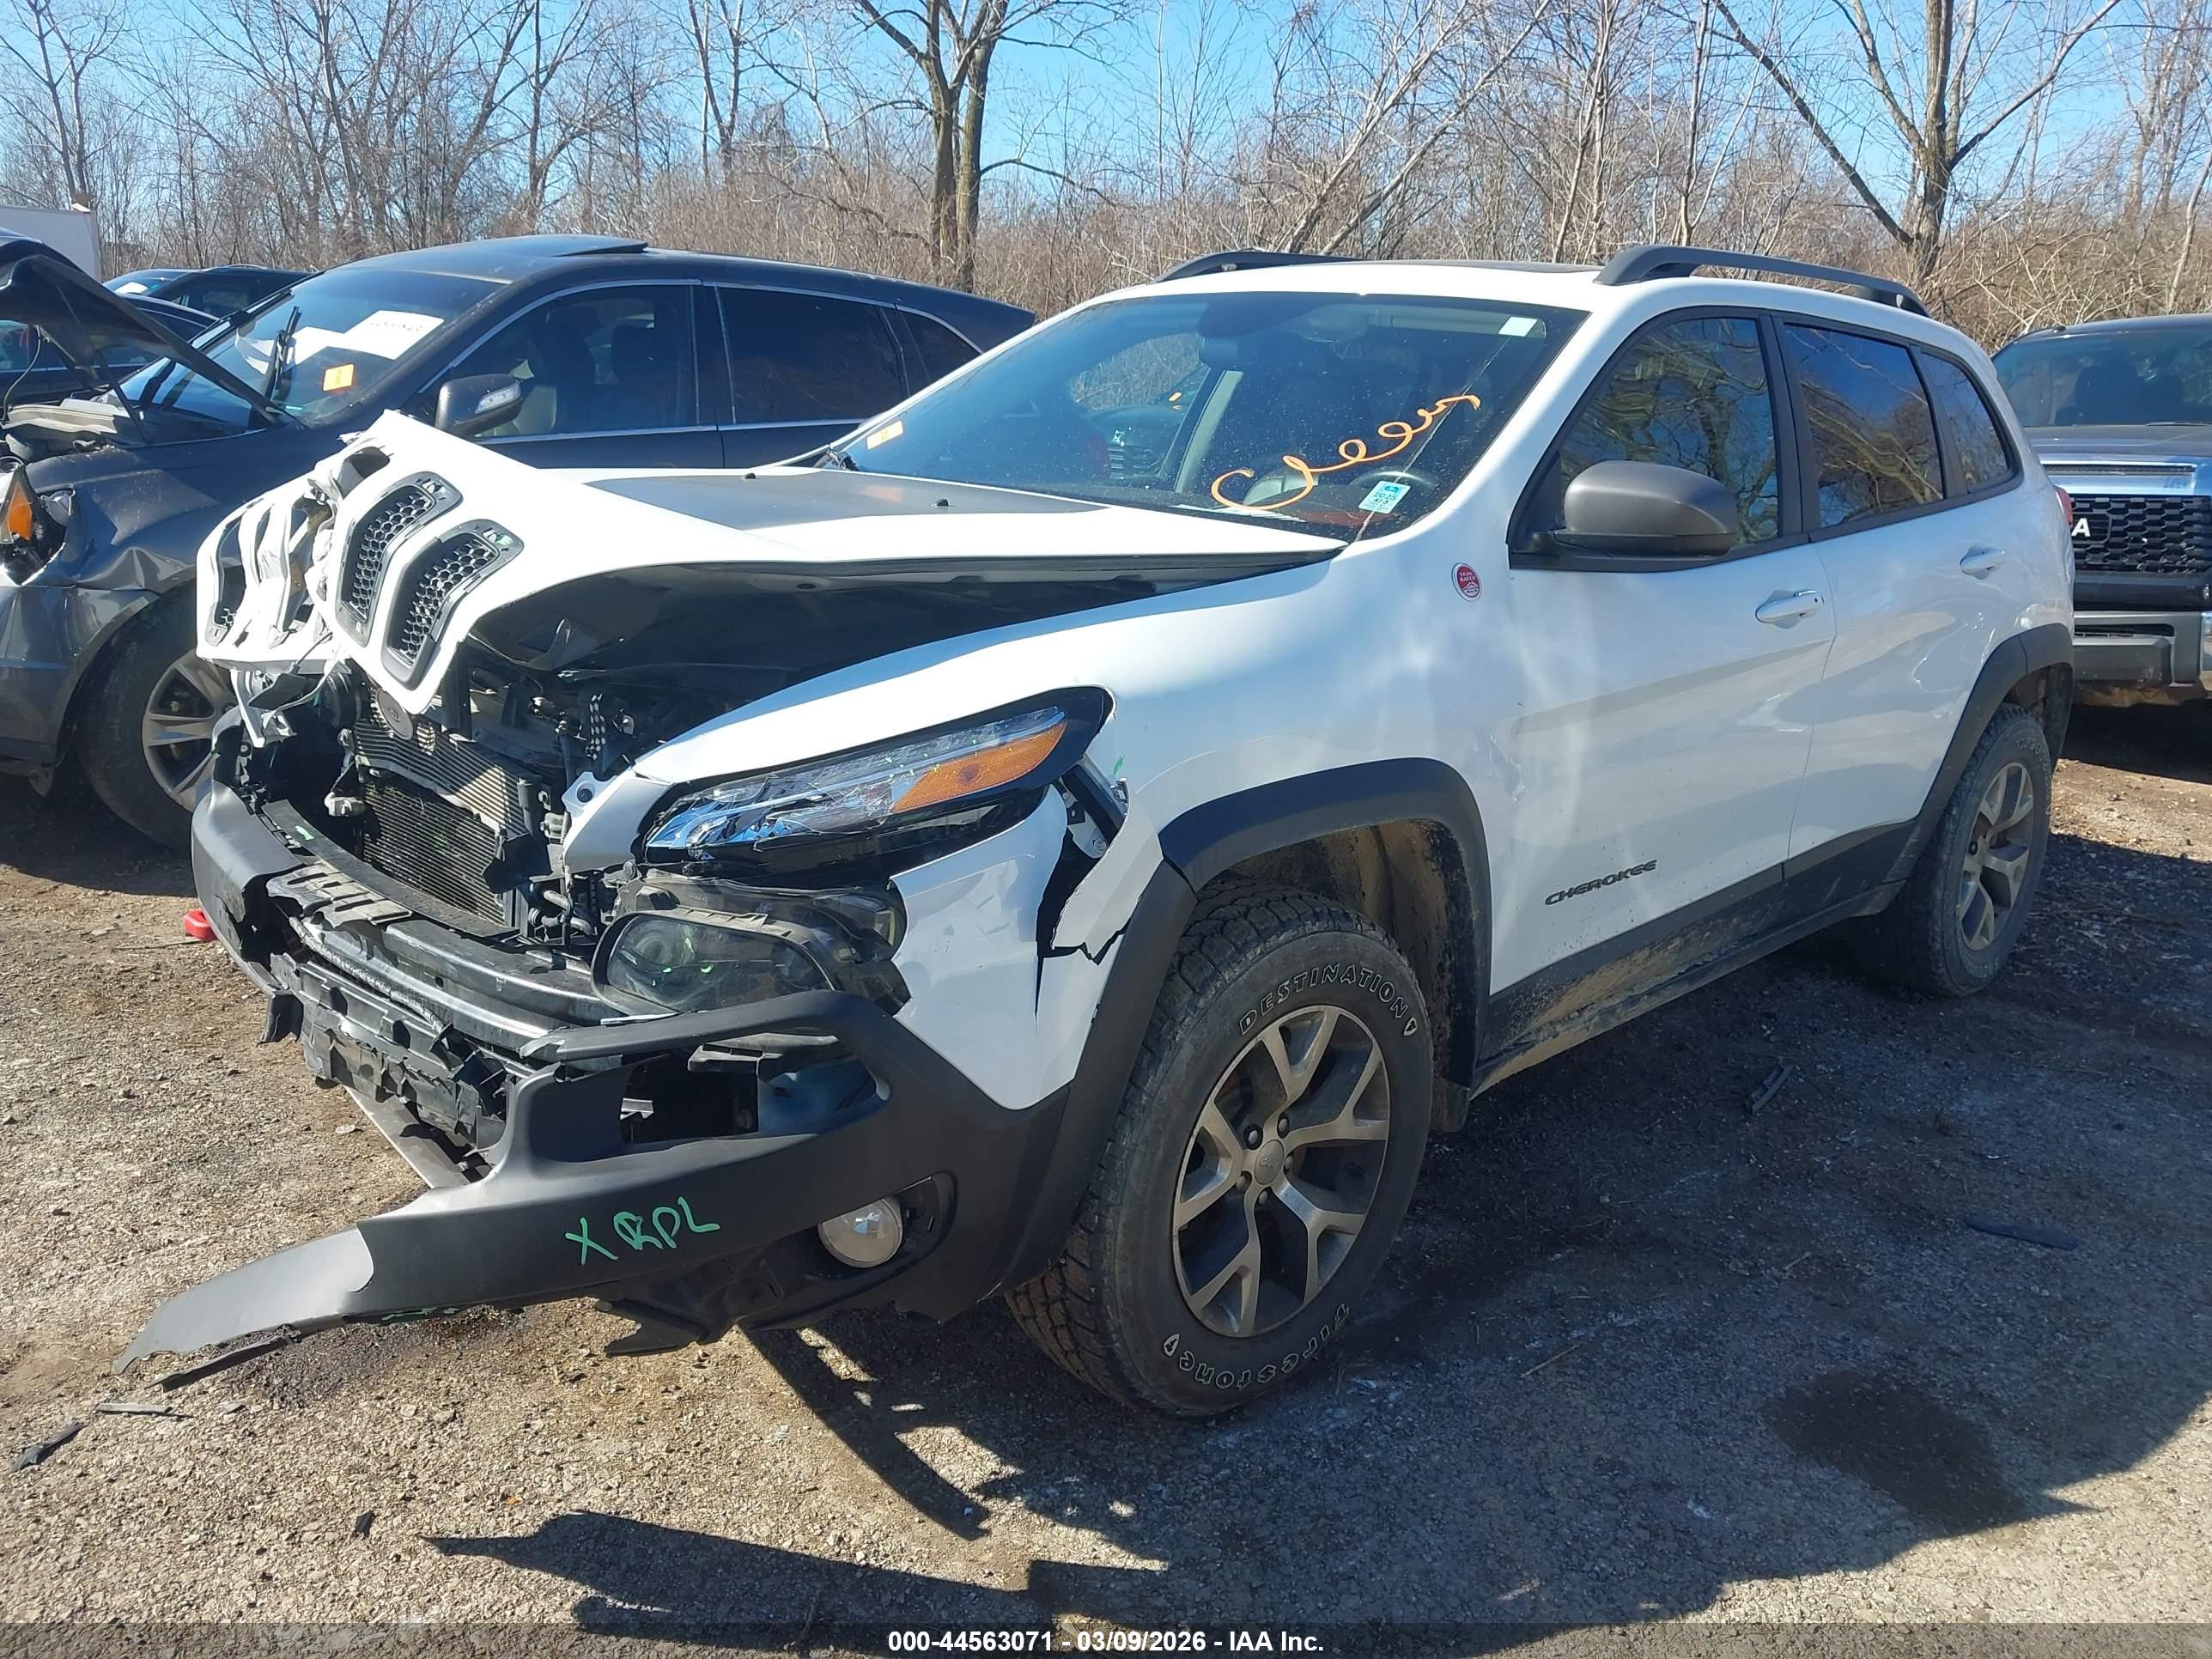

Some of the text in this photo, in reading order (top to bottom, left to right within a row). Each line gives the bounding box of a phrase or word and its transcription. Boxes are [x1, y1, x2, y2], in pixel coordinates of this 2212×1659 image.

[1545, 859, 1657, 906] CHEROKEE
[1239, 963, 1409, 1036] DESTINATION
[564, 1217, 619, 1267] X
[1179, 1303, 1350, 1389] Firestone
